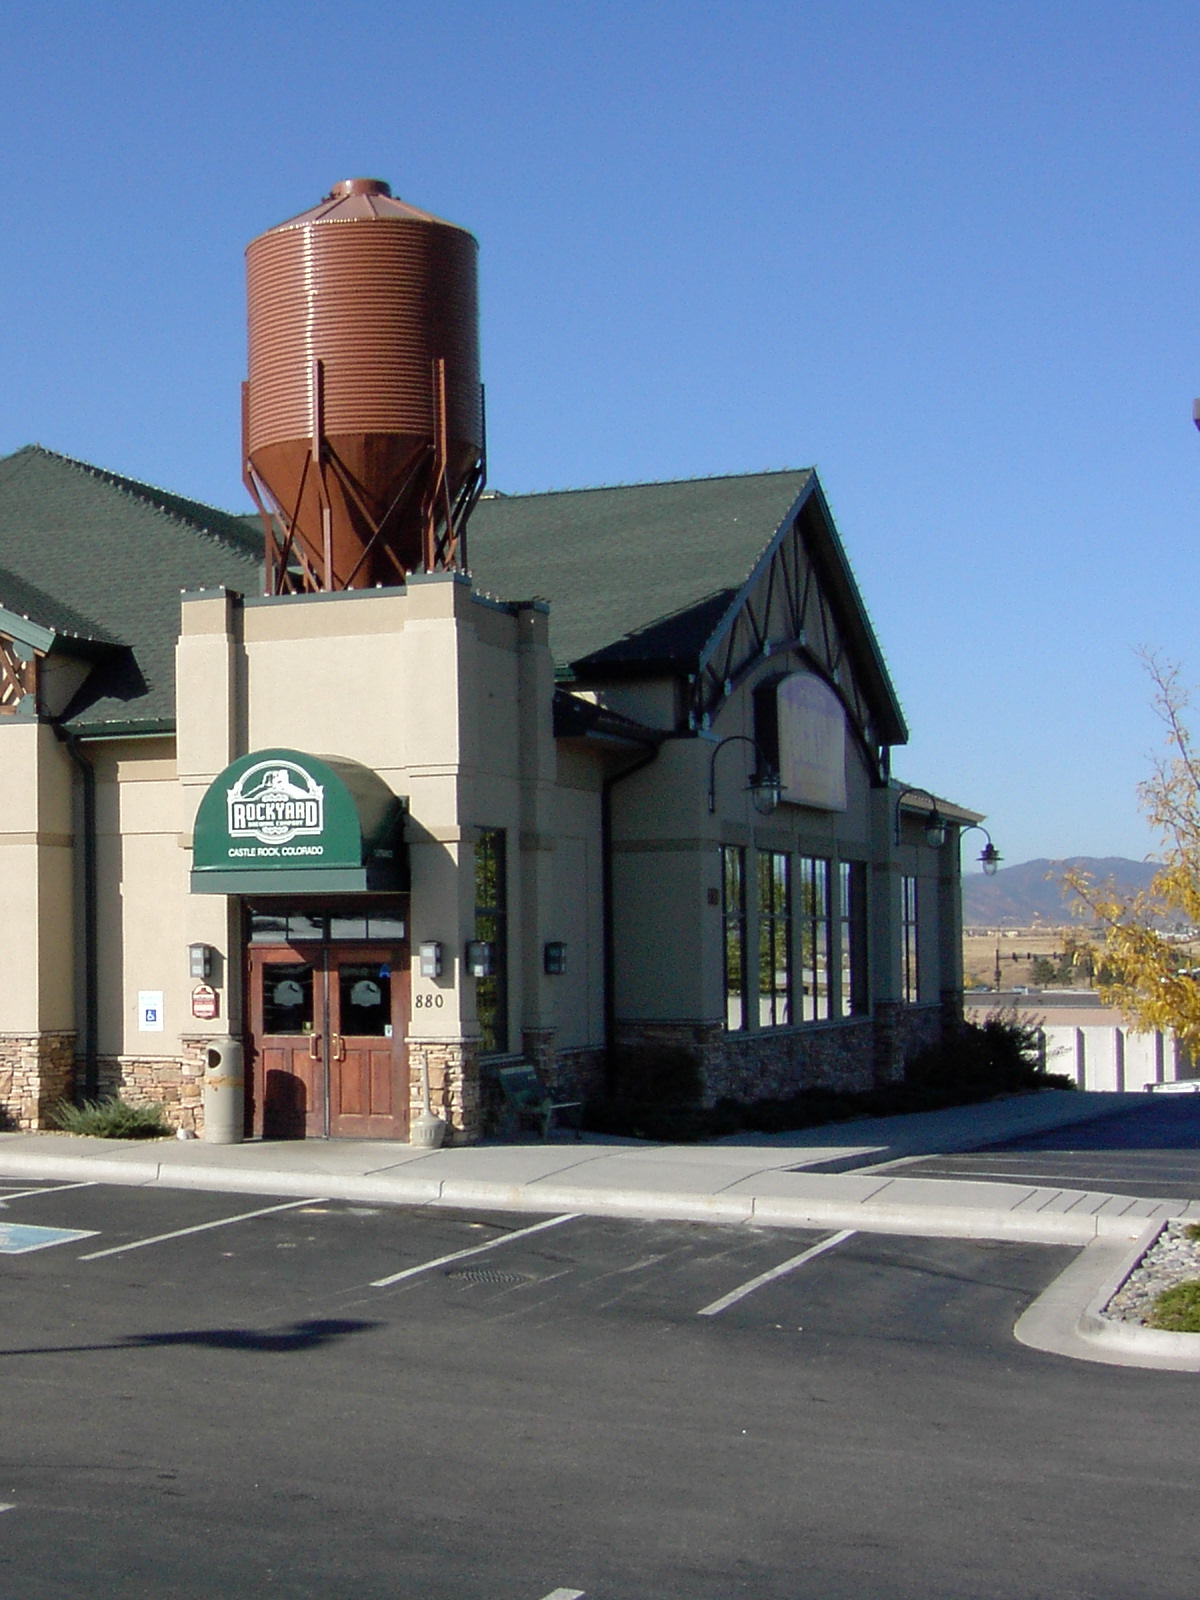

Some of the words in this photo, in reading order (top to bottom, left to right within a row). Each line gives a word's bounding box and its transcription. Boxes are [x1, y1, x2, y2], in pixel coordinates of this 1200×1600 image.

[234, 802, 317, 828] ROCKYARD
[228, 848, 256, 857] CASTLE
[257, 847, 280, 856] ROCK,
[281, 846, 323, 856] COLORADO
[415, 994, 443, 1008] 880
